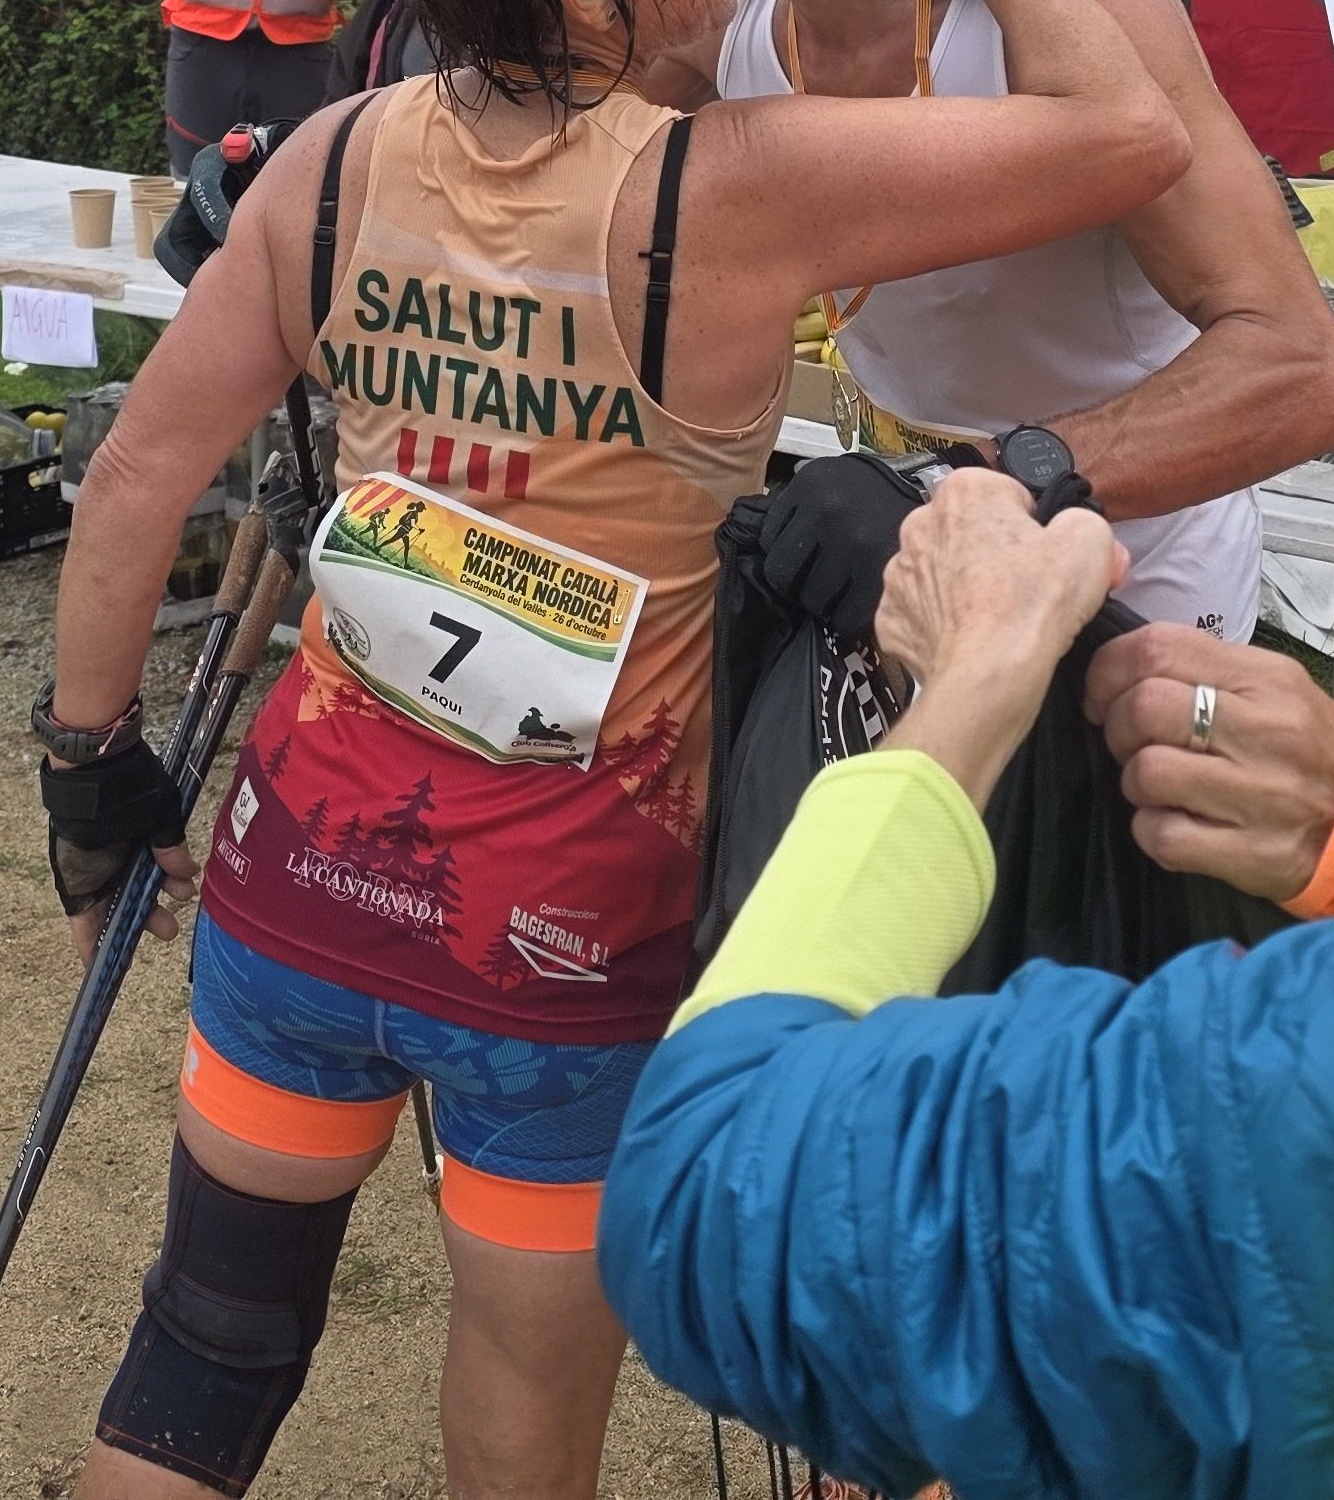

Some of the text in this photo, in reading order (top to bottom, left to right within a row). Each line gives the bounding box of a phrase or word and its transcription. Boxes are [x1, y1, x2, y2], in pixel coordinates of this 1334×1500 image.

[354, 268, 576, 367] SALUT I
[319, 339, 646, 448] MUNTANYA
[462, 552, 612, 629] MARXA NÒRDICA
[463, 527, 619, 607] CAMPIONAT CATALÀ
[460, 573, 607, 641] Cerdanyola del Vallès 26 d'octubre
[1196, 613, 1224, 629] AG+
[427, 611, 483, 685] 7
[421, 686, 463, 715] PAQUI
[285, 852, 309, 879] LA
[509, 905, 586, 962] BAGESFRAN,
[539, 902, 601, 921] Construccions
